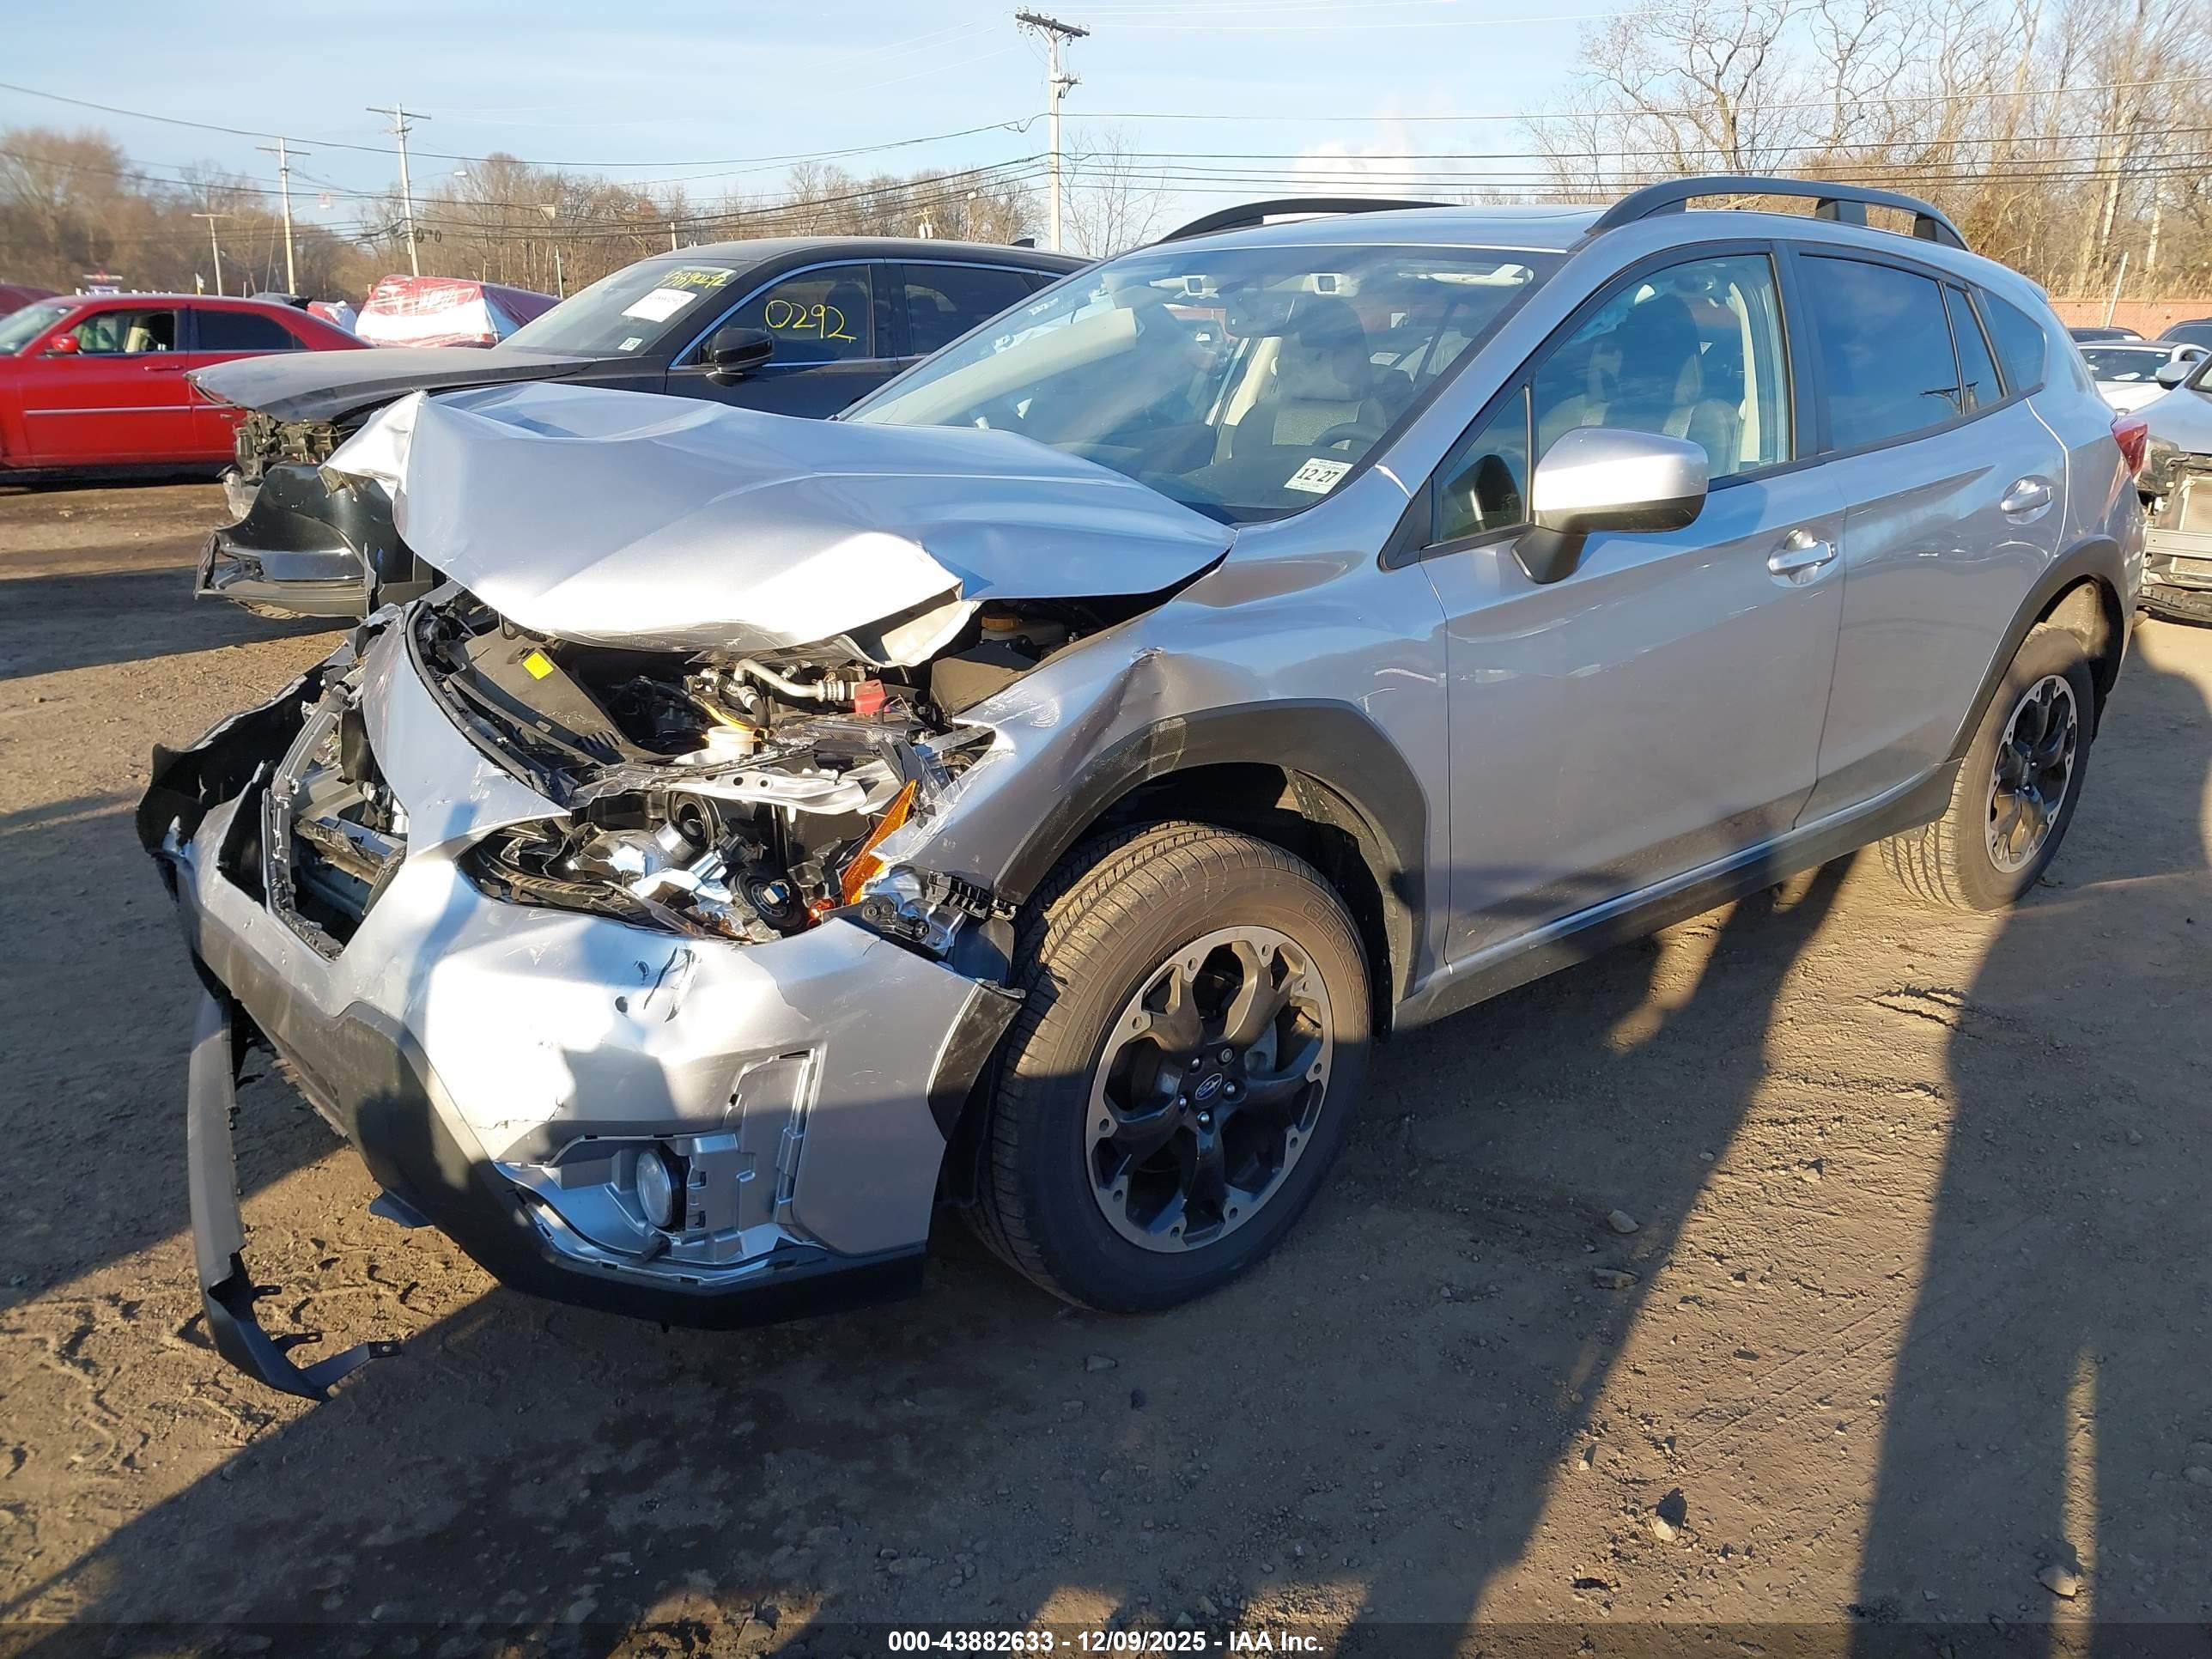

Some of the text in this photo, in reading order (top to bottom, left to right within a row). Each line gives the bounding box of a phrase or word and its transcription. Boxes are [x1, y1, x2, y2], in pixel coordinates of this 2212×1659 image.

[764, 299, 858, 343] 0292
[1297, 468, 1340, 483] 12 27
